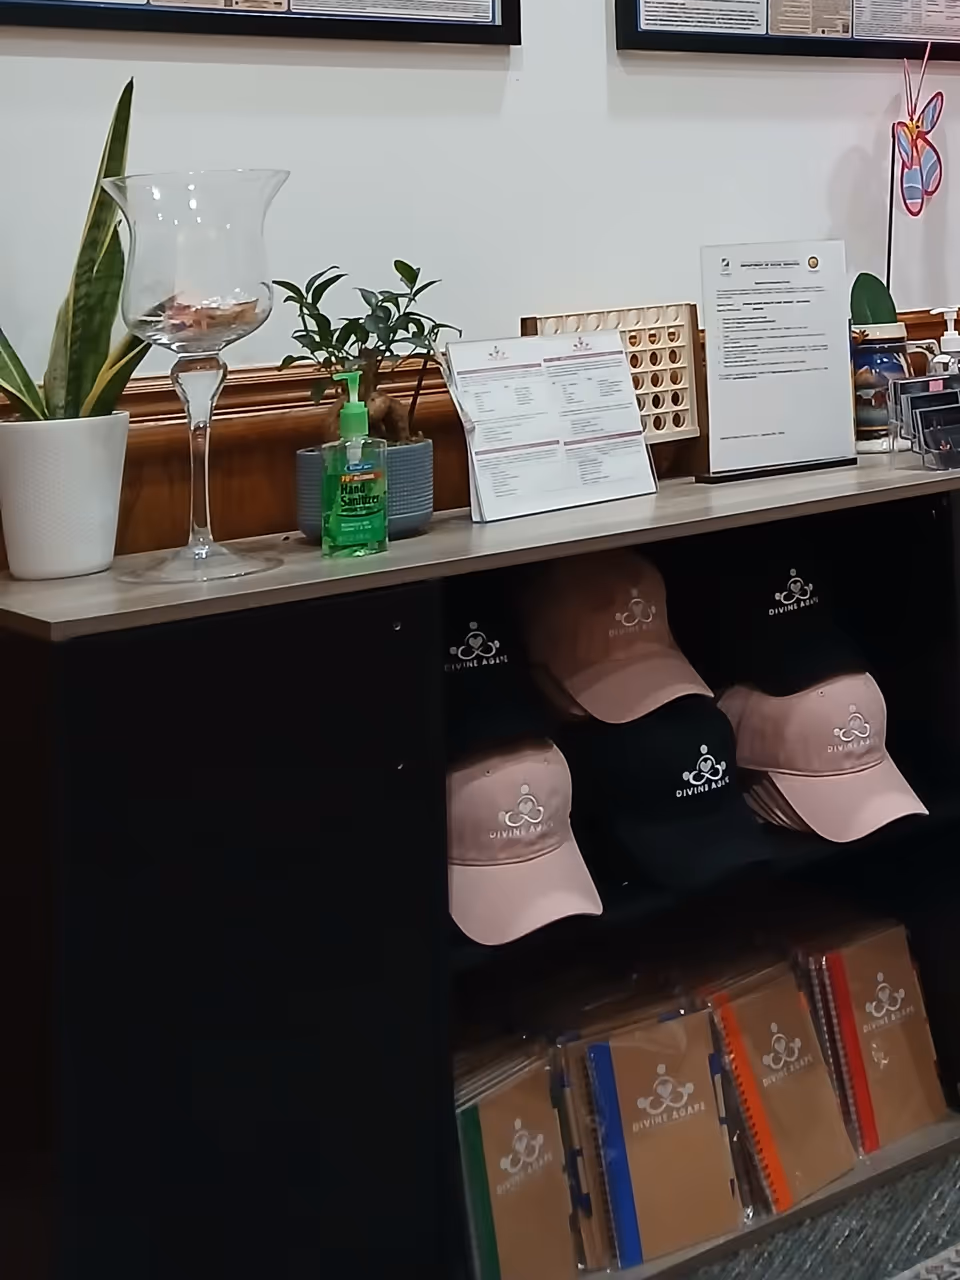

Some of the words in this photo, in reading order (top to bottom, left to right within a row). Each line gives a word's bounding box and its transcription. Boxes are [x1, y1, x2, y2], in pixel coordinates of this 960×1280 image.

[341, 482, 366, 495] Hand
[341, 494, 380, 508] Sanitizer
[768, 602, 798, 616] DIVINE
[444, 659, 478, 672] DIVINE
[827, 742, 858, 753] DIVINE
[675, 783, 709, 798] DIVINE
[488, 827, 525, 839] DIVINE
[631, 1112, 668, 1134] DIVINE
[671, 1100, 706, 1120] AGAPE
